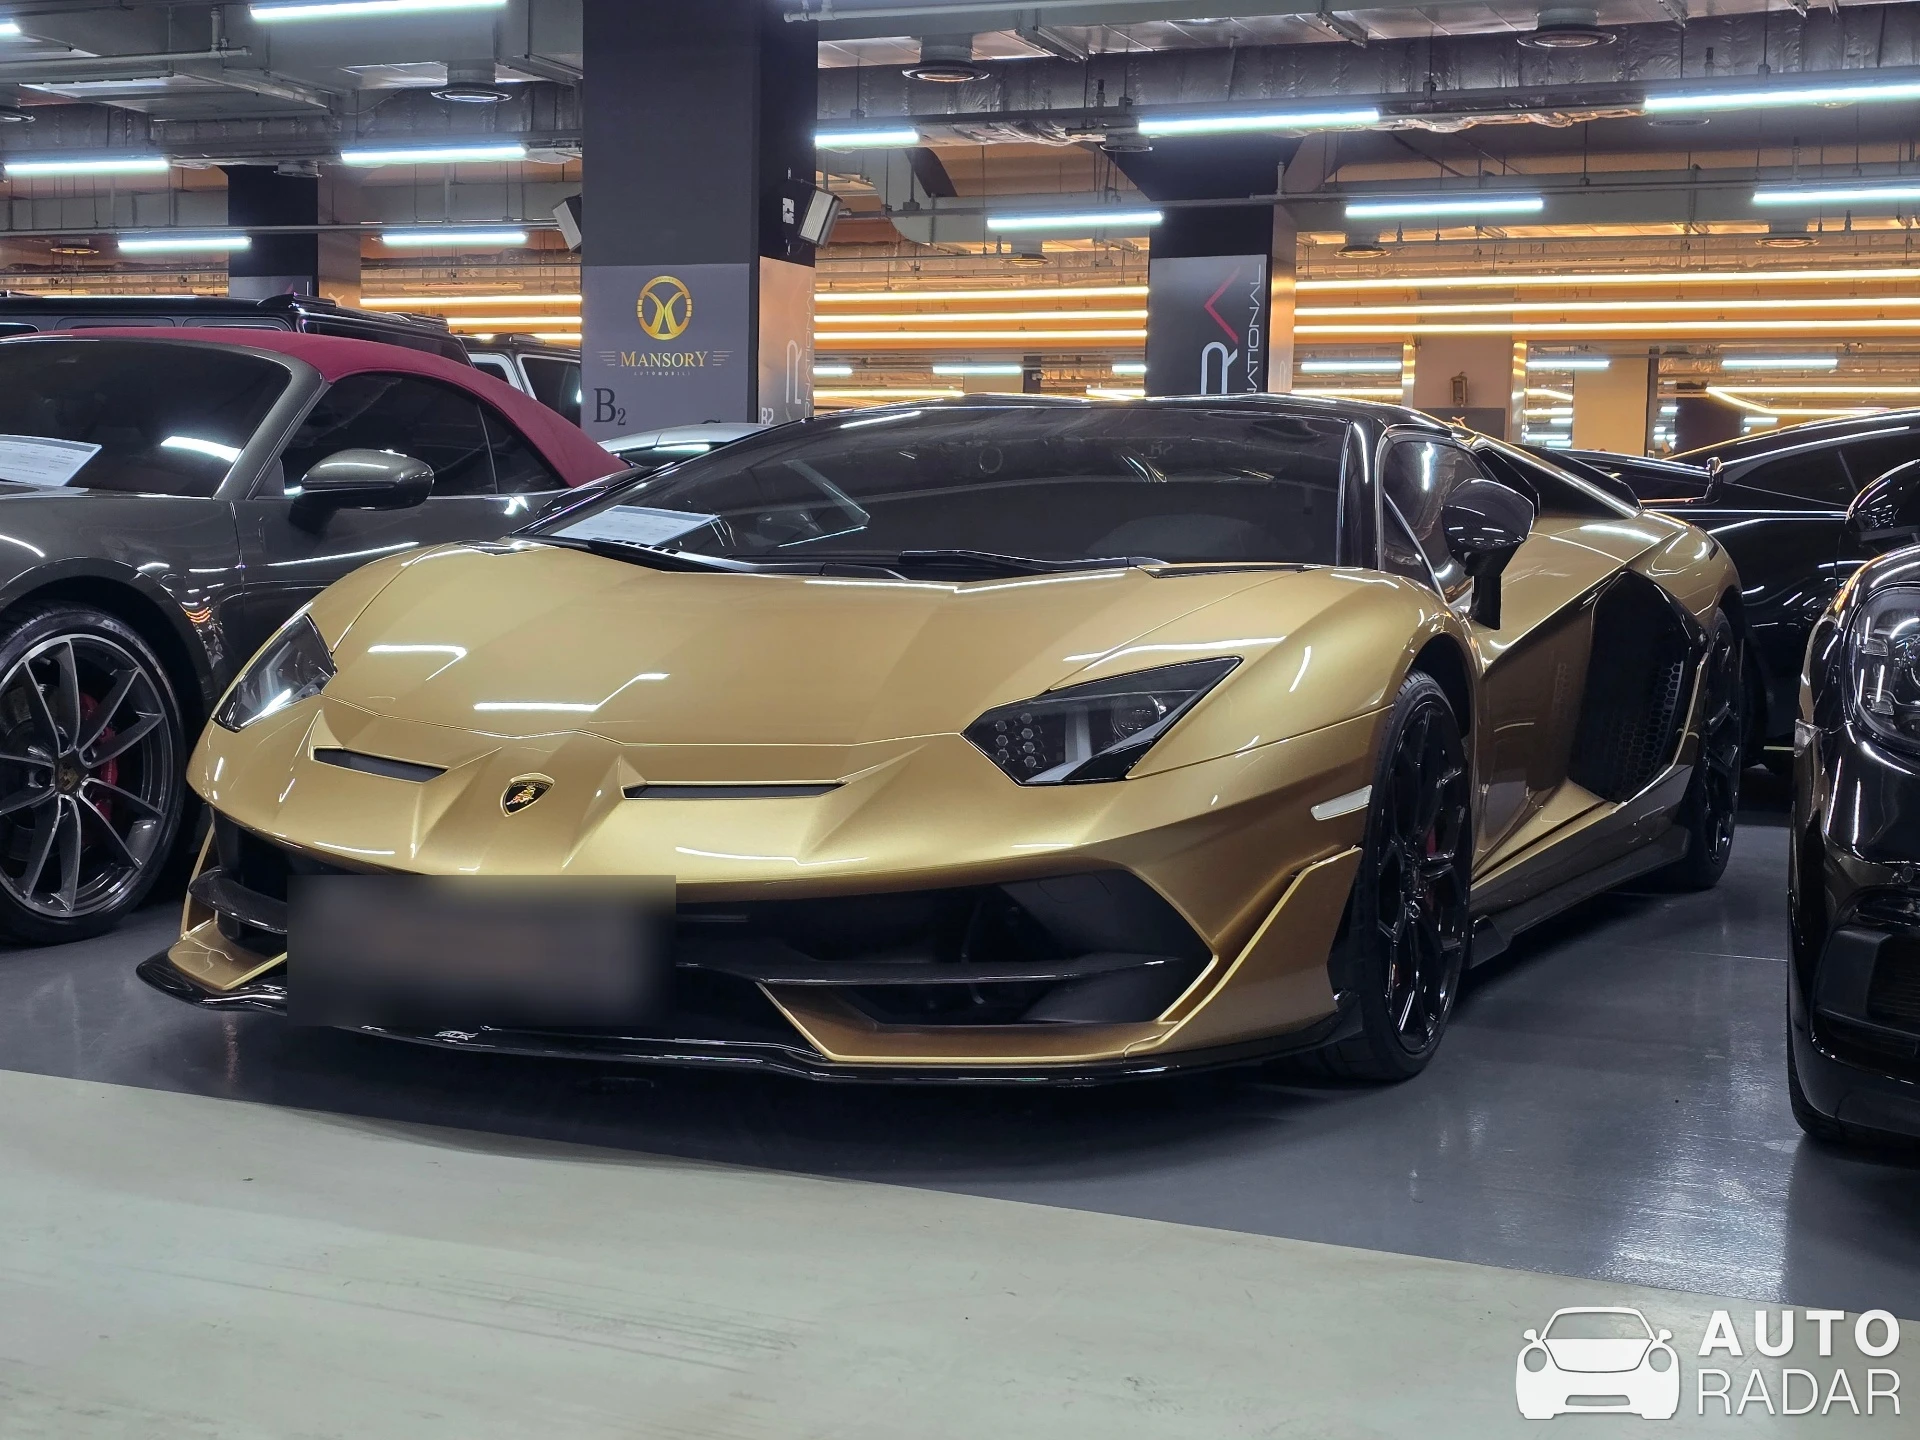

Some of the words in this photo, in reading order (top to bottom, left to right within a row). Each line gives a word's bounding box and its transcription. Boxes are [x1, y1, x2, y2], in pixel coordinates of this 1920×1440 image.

[1247, 264, 1261, 394] ATIONAL
[620, 351, 708, 367] MANSORY
[593, 388, 626, 426] B2
